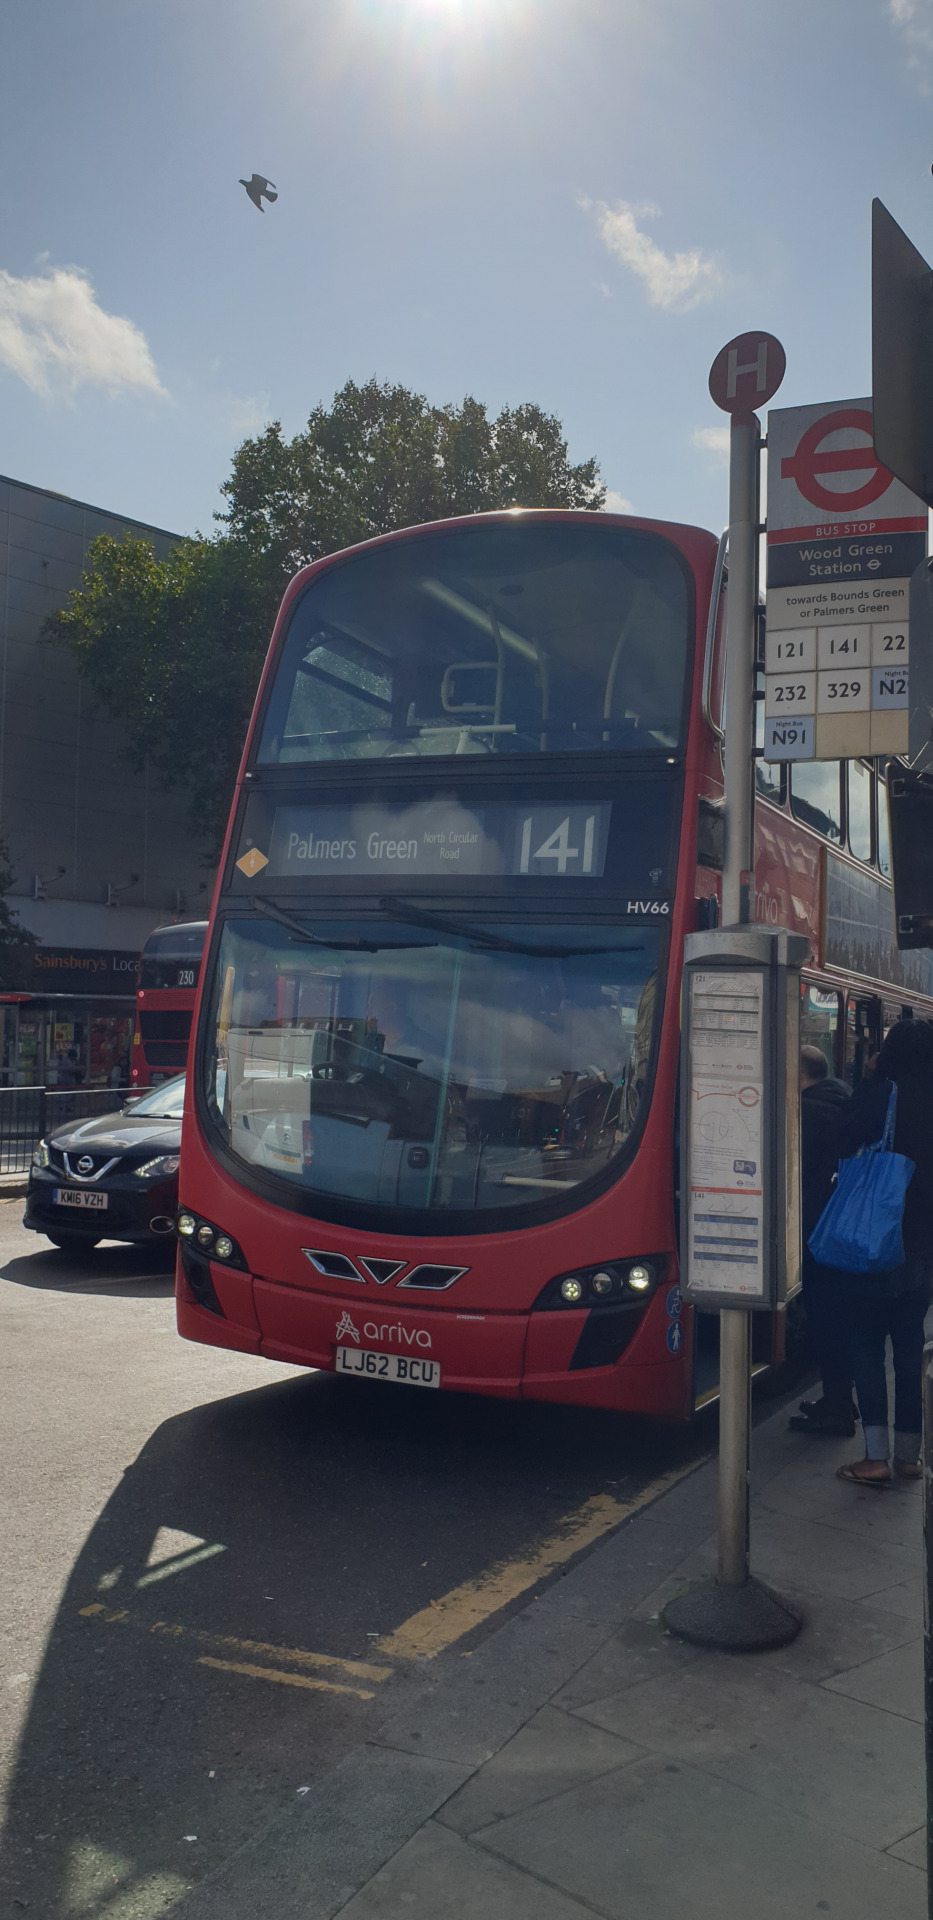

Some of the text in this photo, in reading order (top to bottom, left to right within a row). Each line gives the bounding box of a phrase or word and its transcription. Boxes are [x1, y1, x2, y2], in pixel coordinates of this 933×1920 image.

[727, 341, 768, 398] H
[816, 522, 876, 537] BUS STOP
[799, 544, 893, 561] Wood Green
[809, 562, 862, 576] Station
[786, 587, 905, 605] towards Bounds Green
[799, 603, 890, 618] or Palmers Green
[777, 641, 804, 659] 121
[830, 637, 858, 655] 141
[883, 635, 906, 651] 22
[774, 685, 807, 702] 232
[827, 681, 862, 698] 329
[879, 679, 909, 696] N2
[772, 729, 806, 745] N91
[287, 832, 418, 859] Palmers Green
[423, 831, 479, 844] North Circular
[519, 814, 596, 873] 141
[439, 847, 460, 859] Road
[626, 901, 670, 914] HV66
[34, 953, 142, 973] Sainsbury's Loca
[179, 970, 194, 985] 230
[61, 1190, 104, 1206] KM16 VZH
[363, 1322, 432, 1348] arriva
[342, 1349, 434, 1382] LJ62 BCU
